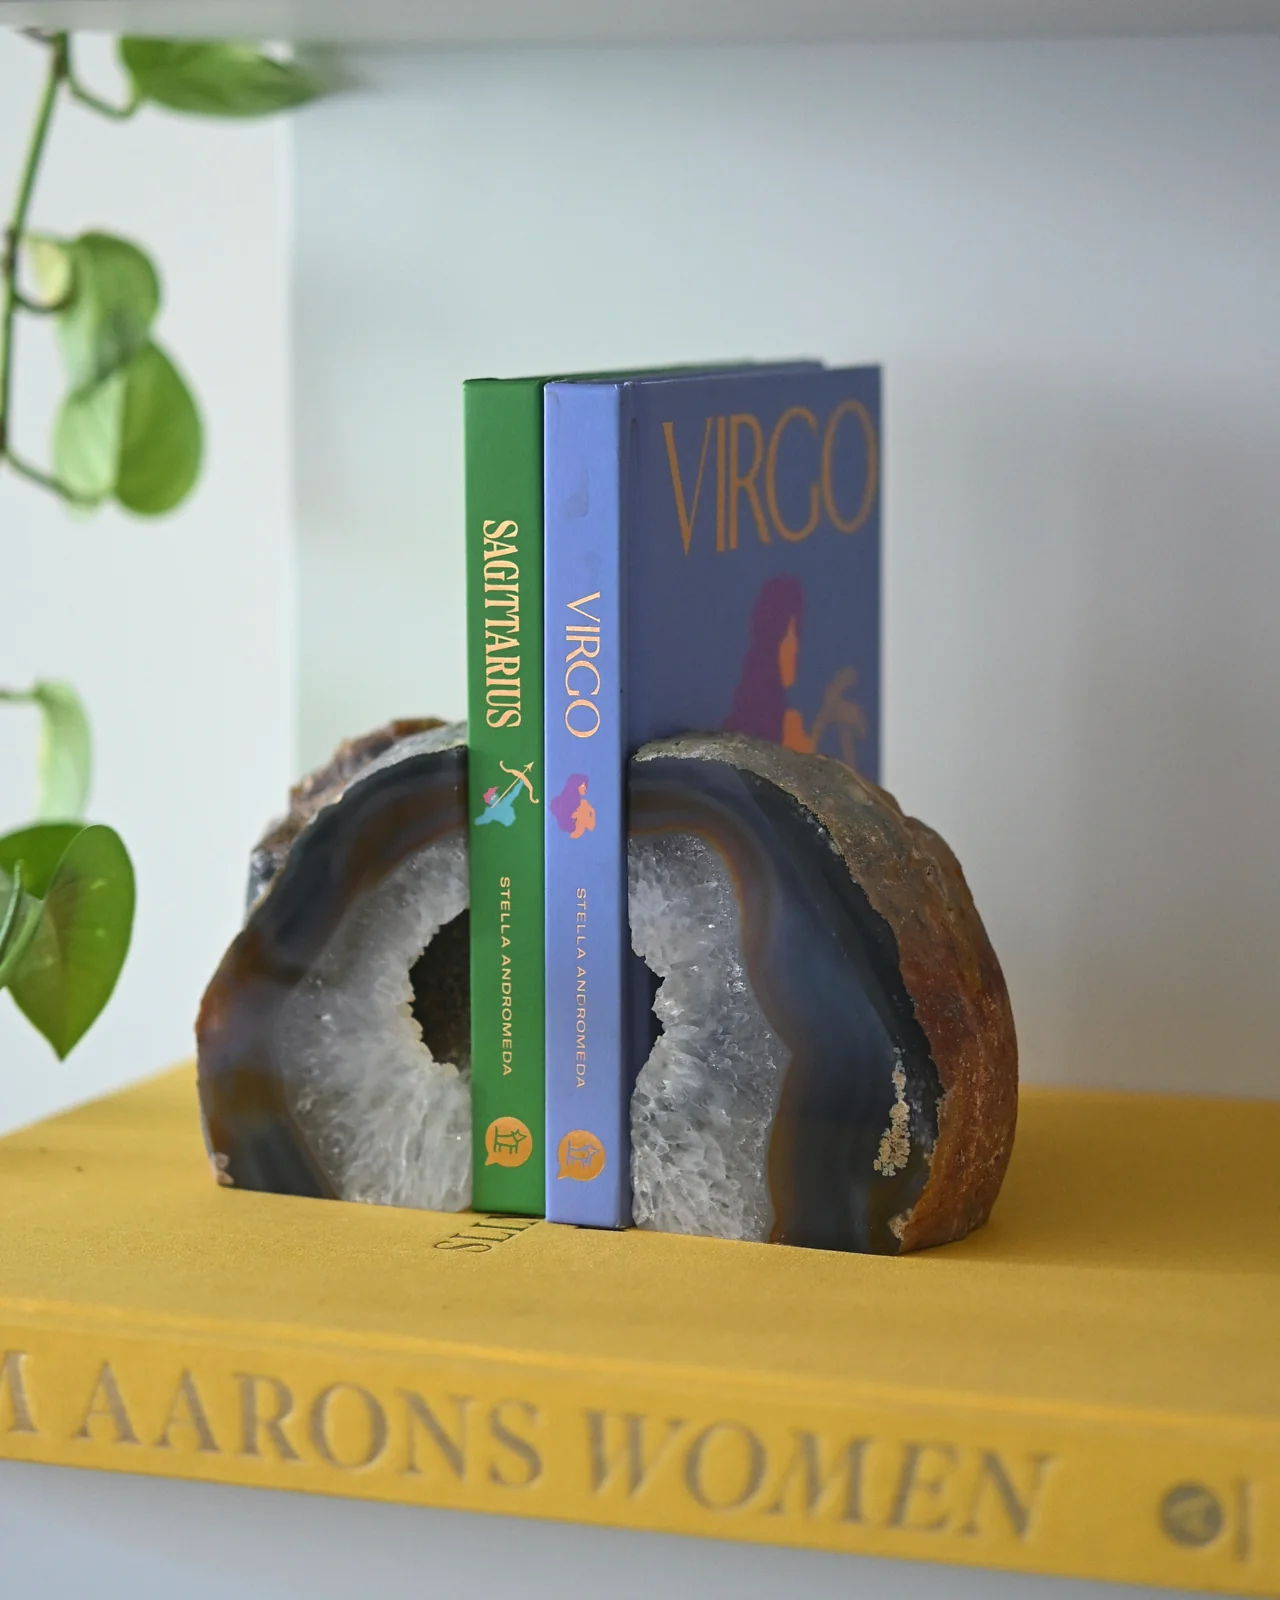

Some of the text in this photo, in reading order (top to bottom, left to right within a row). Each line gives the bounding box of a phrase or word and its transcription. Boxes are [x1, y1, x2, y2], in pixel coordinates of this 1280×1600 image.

[662, 398, 879, 557] VIRGO
[482, 519, 522, 728] SAGITTARIUS
[564, 590, 601, 739] VIRGO
[499, 876, 513, 1076] STELLA ANDROMEDA
[575, 887, 587, 1088] STELLA ANDROMEDA
[433, 1214, 541, 1253] SLI
[70, 1360, 545, 1489] AARONS
[585, 1407, 1057, 1543] WOMEN
